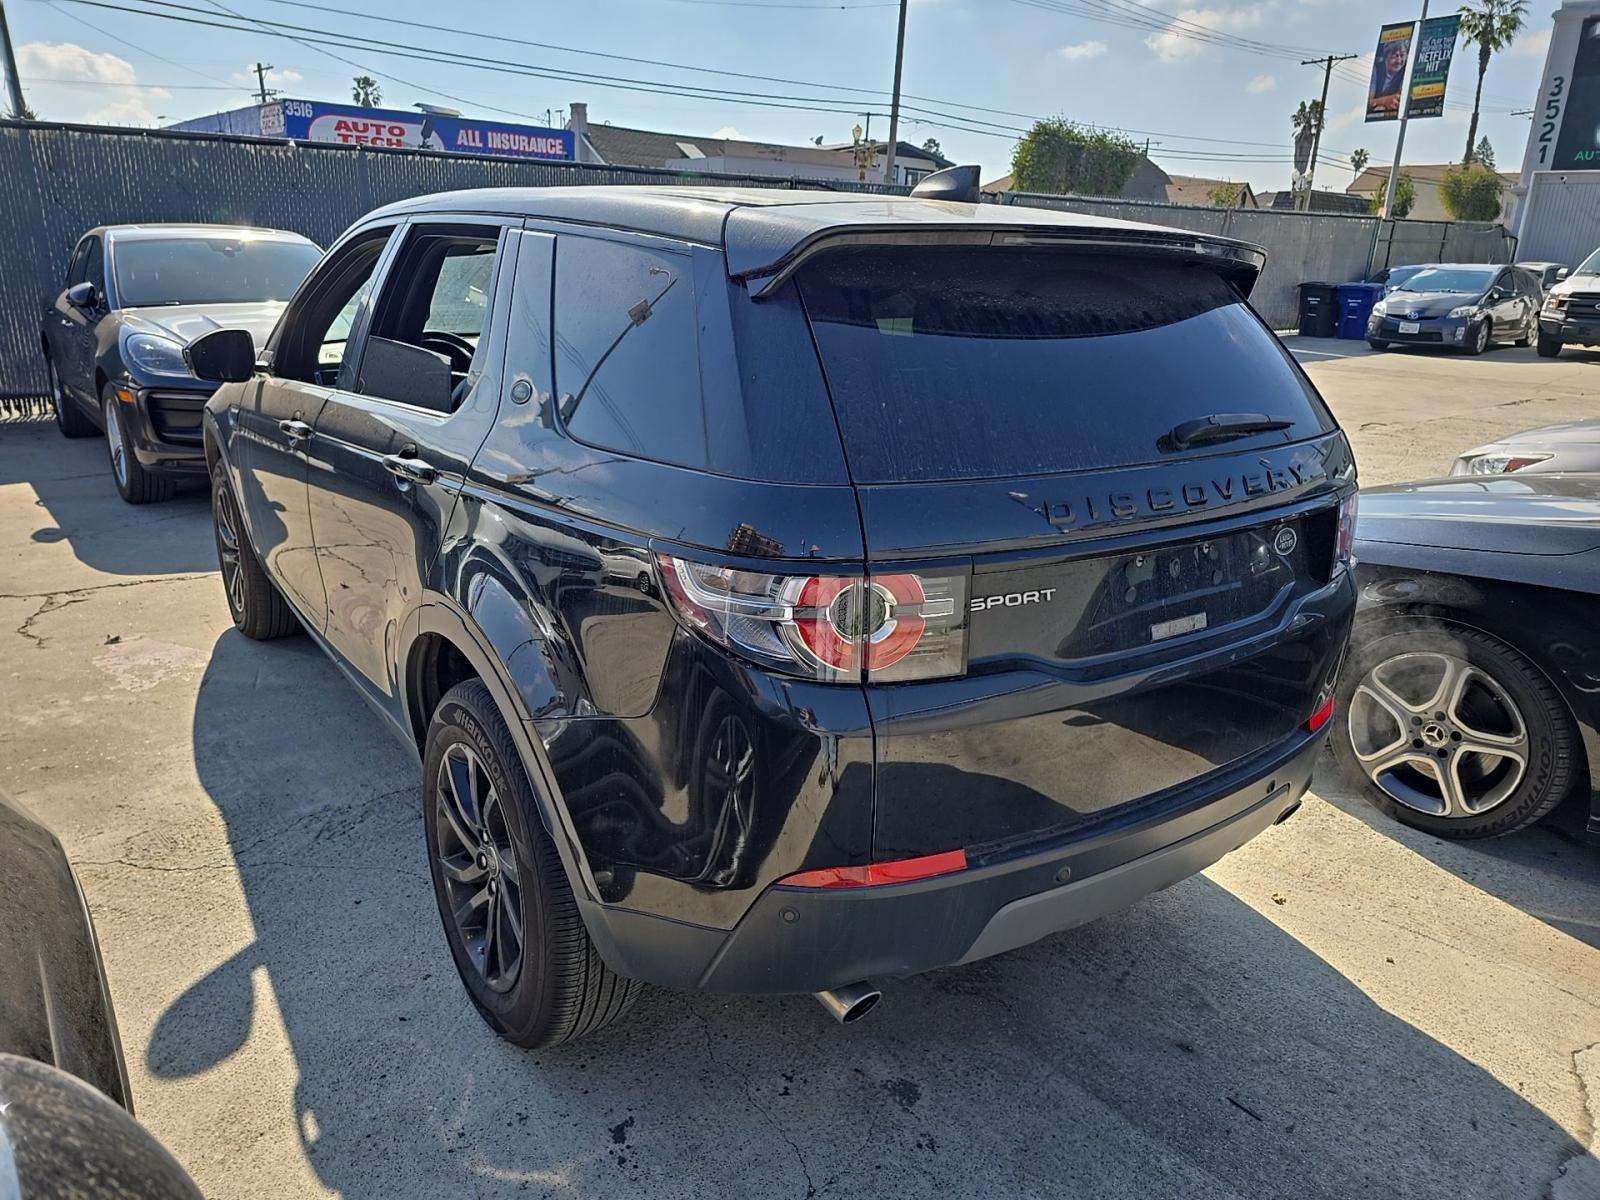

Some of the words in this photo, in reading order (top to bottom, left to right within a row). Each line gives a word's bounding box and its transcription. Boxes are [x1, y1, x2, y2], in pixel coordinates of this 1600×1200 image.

[1419, 49, 1452, 62] NETFLIX
[285, 101, 313, 118] 3516
[1539, 76, 1564, 163] 3521
[334, 120, 406, 137] AUTO
[337, 133, 402, 147] TECH
[457, 130, 482, 147] ALL
[487, 132, 563, 154] INSURANCE
[1043, 464, 1303, 527] DISCOVERY
[970, 588, 1056, 611] SPORT
